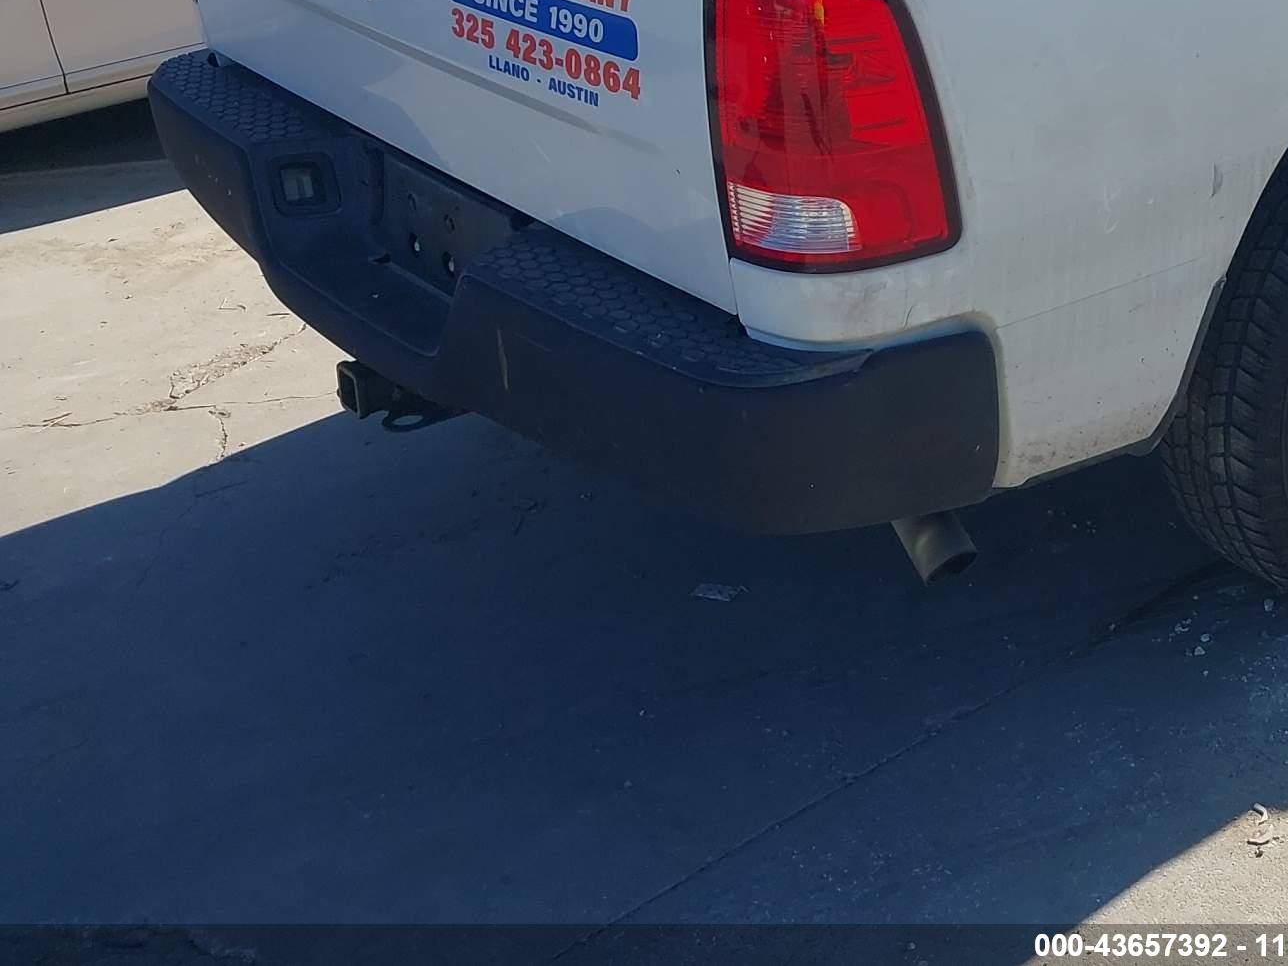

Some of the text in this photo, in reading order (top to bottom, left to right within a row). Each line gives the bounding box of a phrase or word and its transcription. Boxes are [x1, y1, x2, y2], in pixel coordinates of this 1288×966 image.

[549, 6, 604, 43] 1990
[451, 7, 641, 100] 325 423-0864
[489, 55, 530, 81] LLANO
[548, 78, 599, 107] AUSTIN
